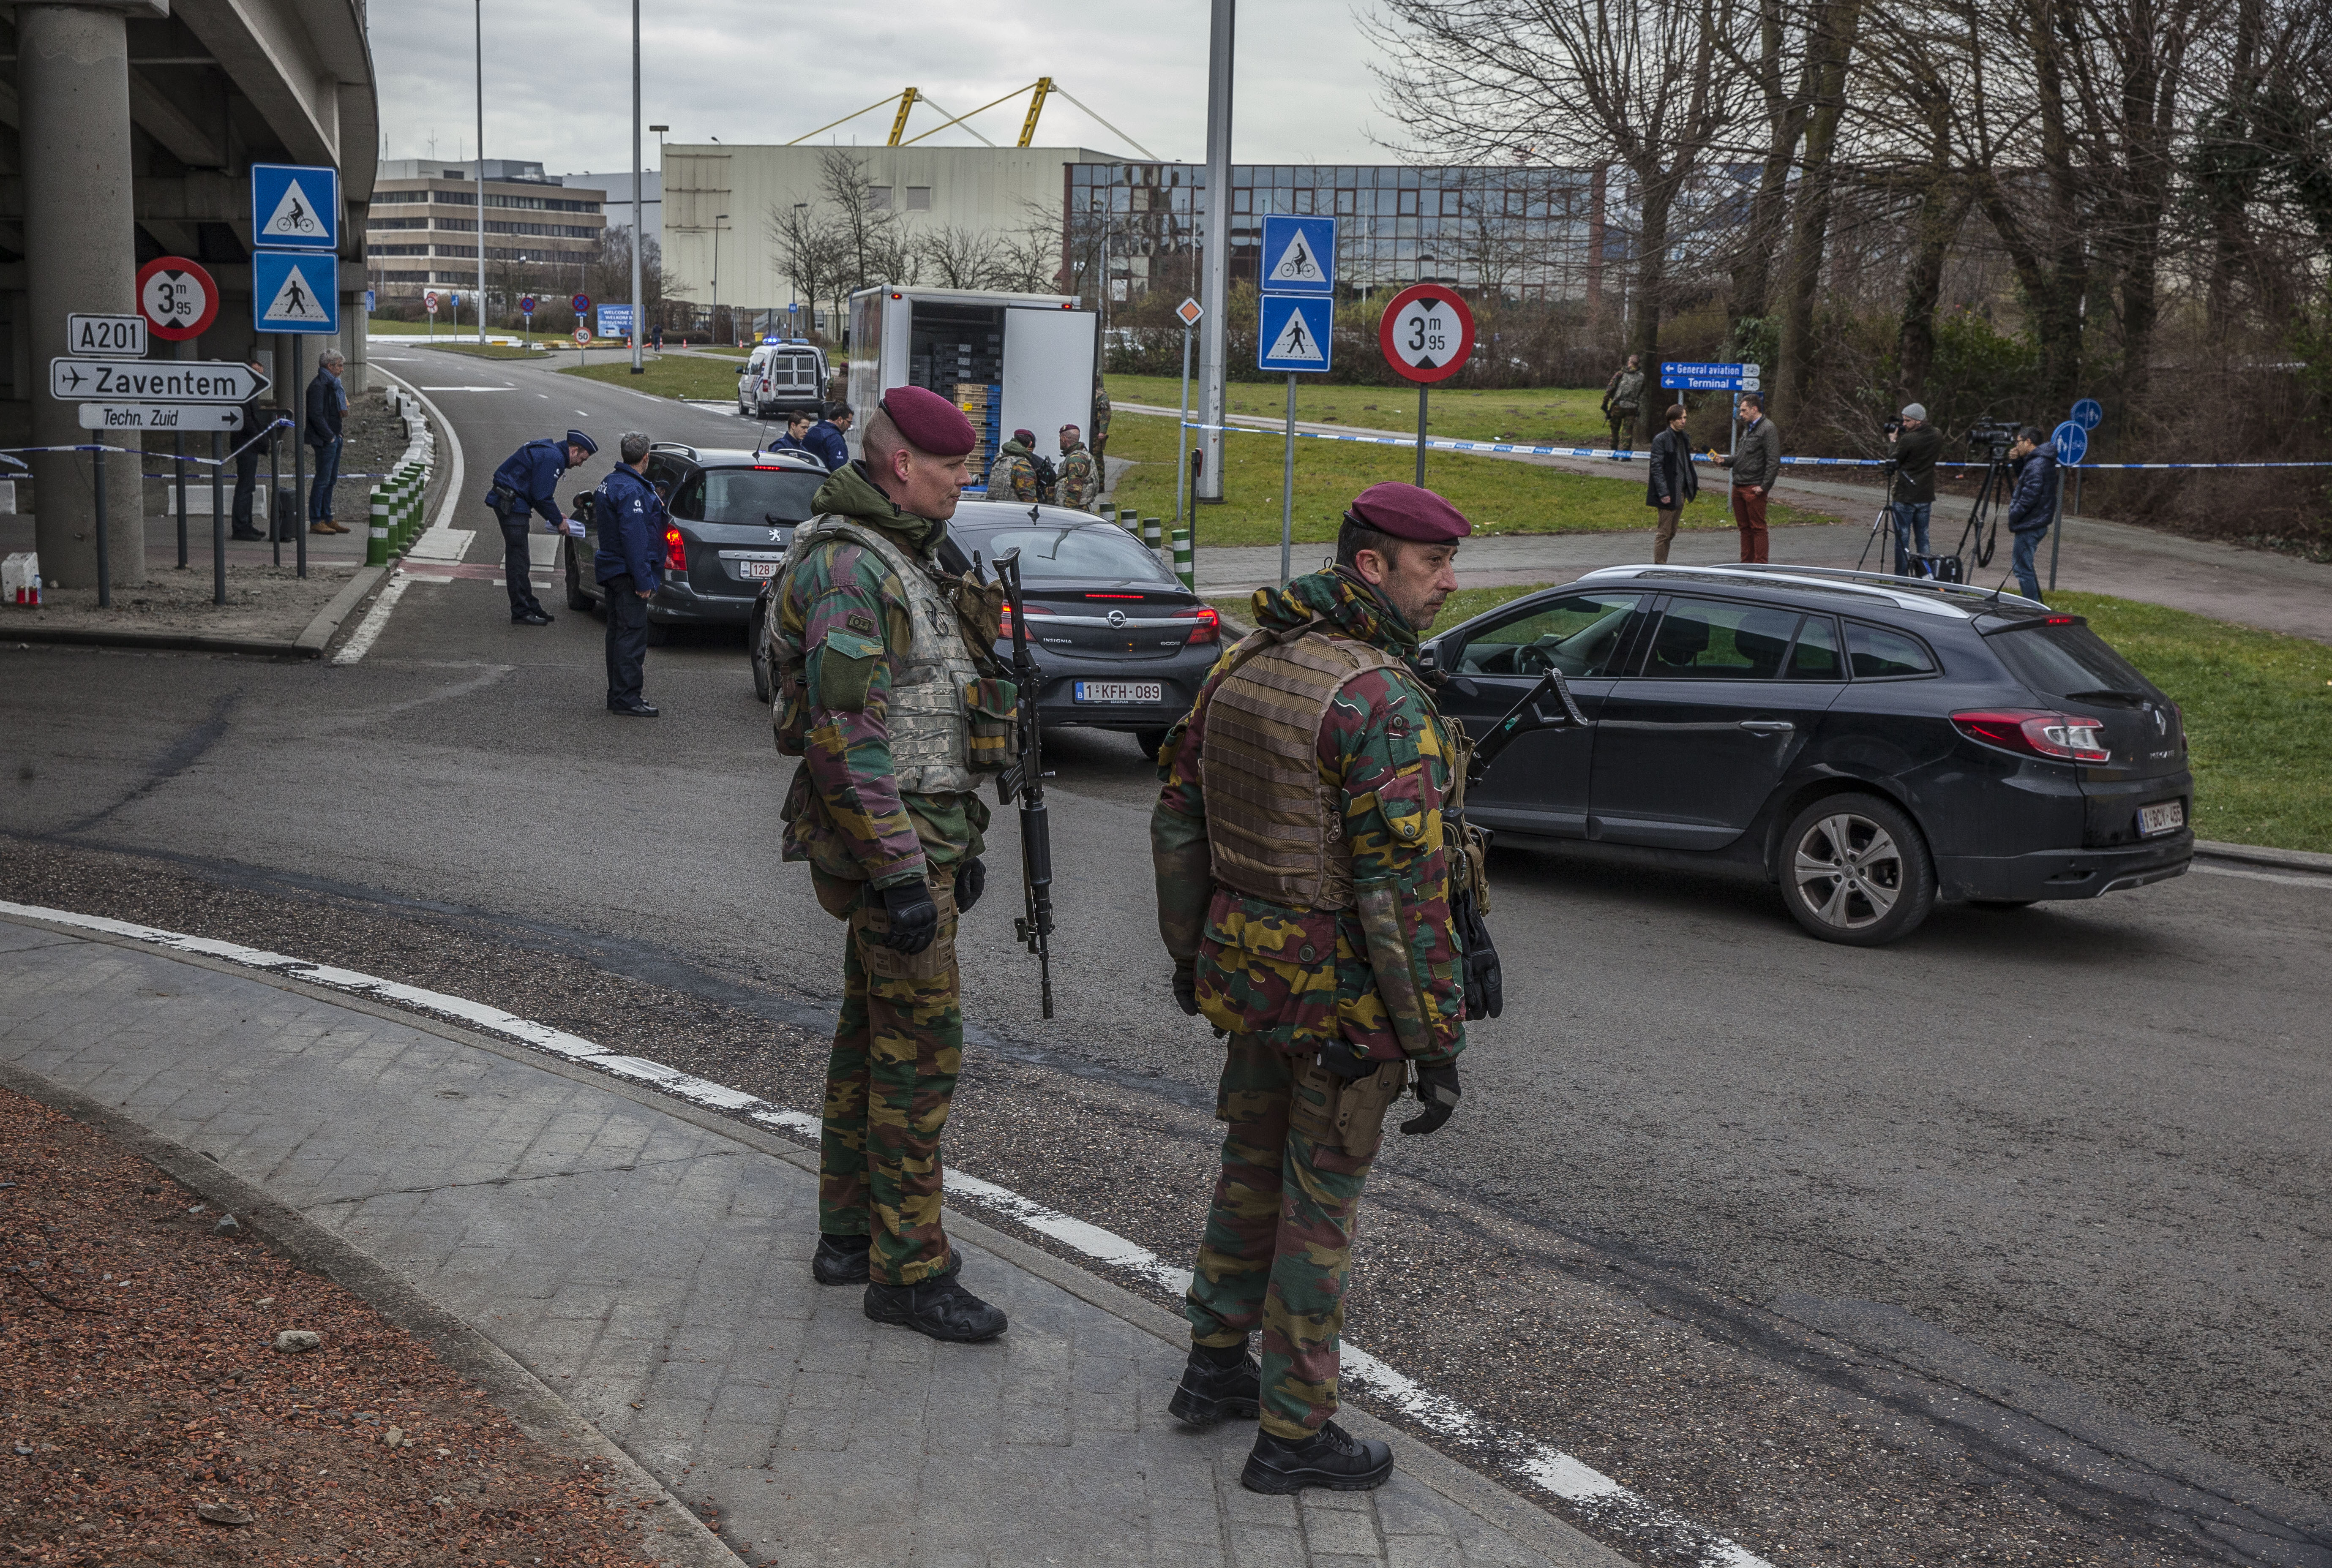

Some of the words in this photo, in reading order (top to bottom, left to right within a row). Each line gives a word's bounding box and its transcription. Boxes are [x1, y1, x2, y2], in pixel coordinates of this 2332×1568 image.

[158, 283, 175, 313] 3
[176, 284, 186, 294] m
[176, 301, 191, 315] 95
[81, 322, 136, 349] A201
[1408, 316, 1425, 351] 3
[1429, 318, 1441, 330] m
[1429, 335, 1445, 350] 95
[1677, 364, 1707, 374] General
[1709, 365, 1740, 375] aviation
[96, 367, 236, 396] Zaventem
[1688, 378, 1729, 388] Terminal
[104, 408, 143, 426] Techn.
[150, 409, 179, 426] Zuid
[853, 617, 866, 627] O+
[1086, 684, 1160, 699] 1-KFH-089
